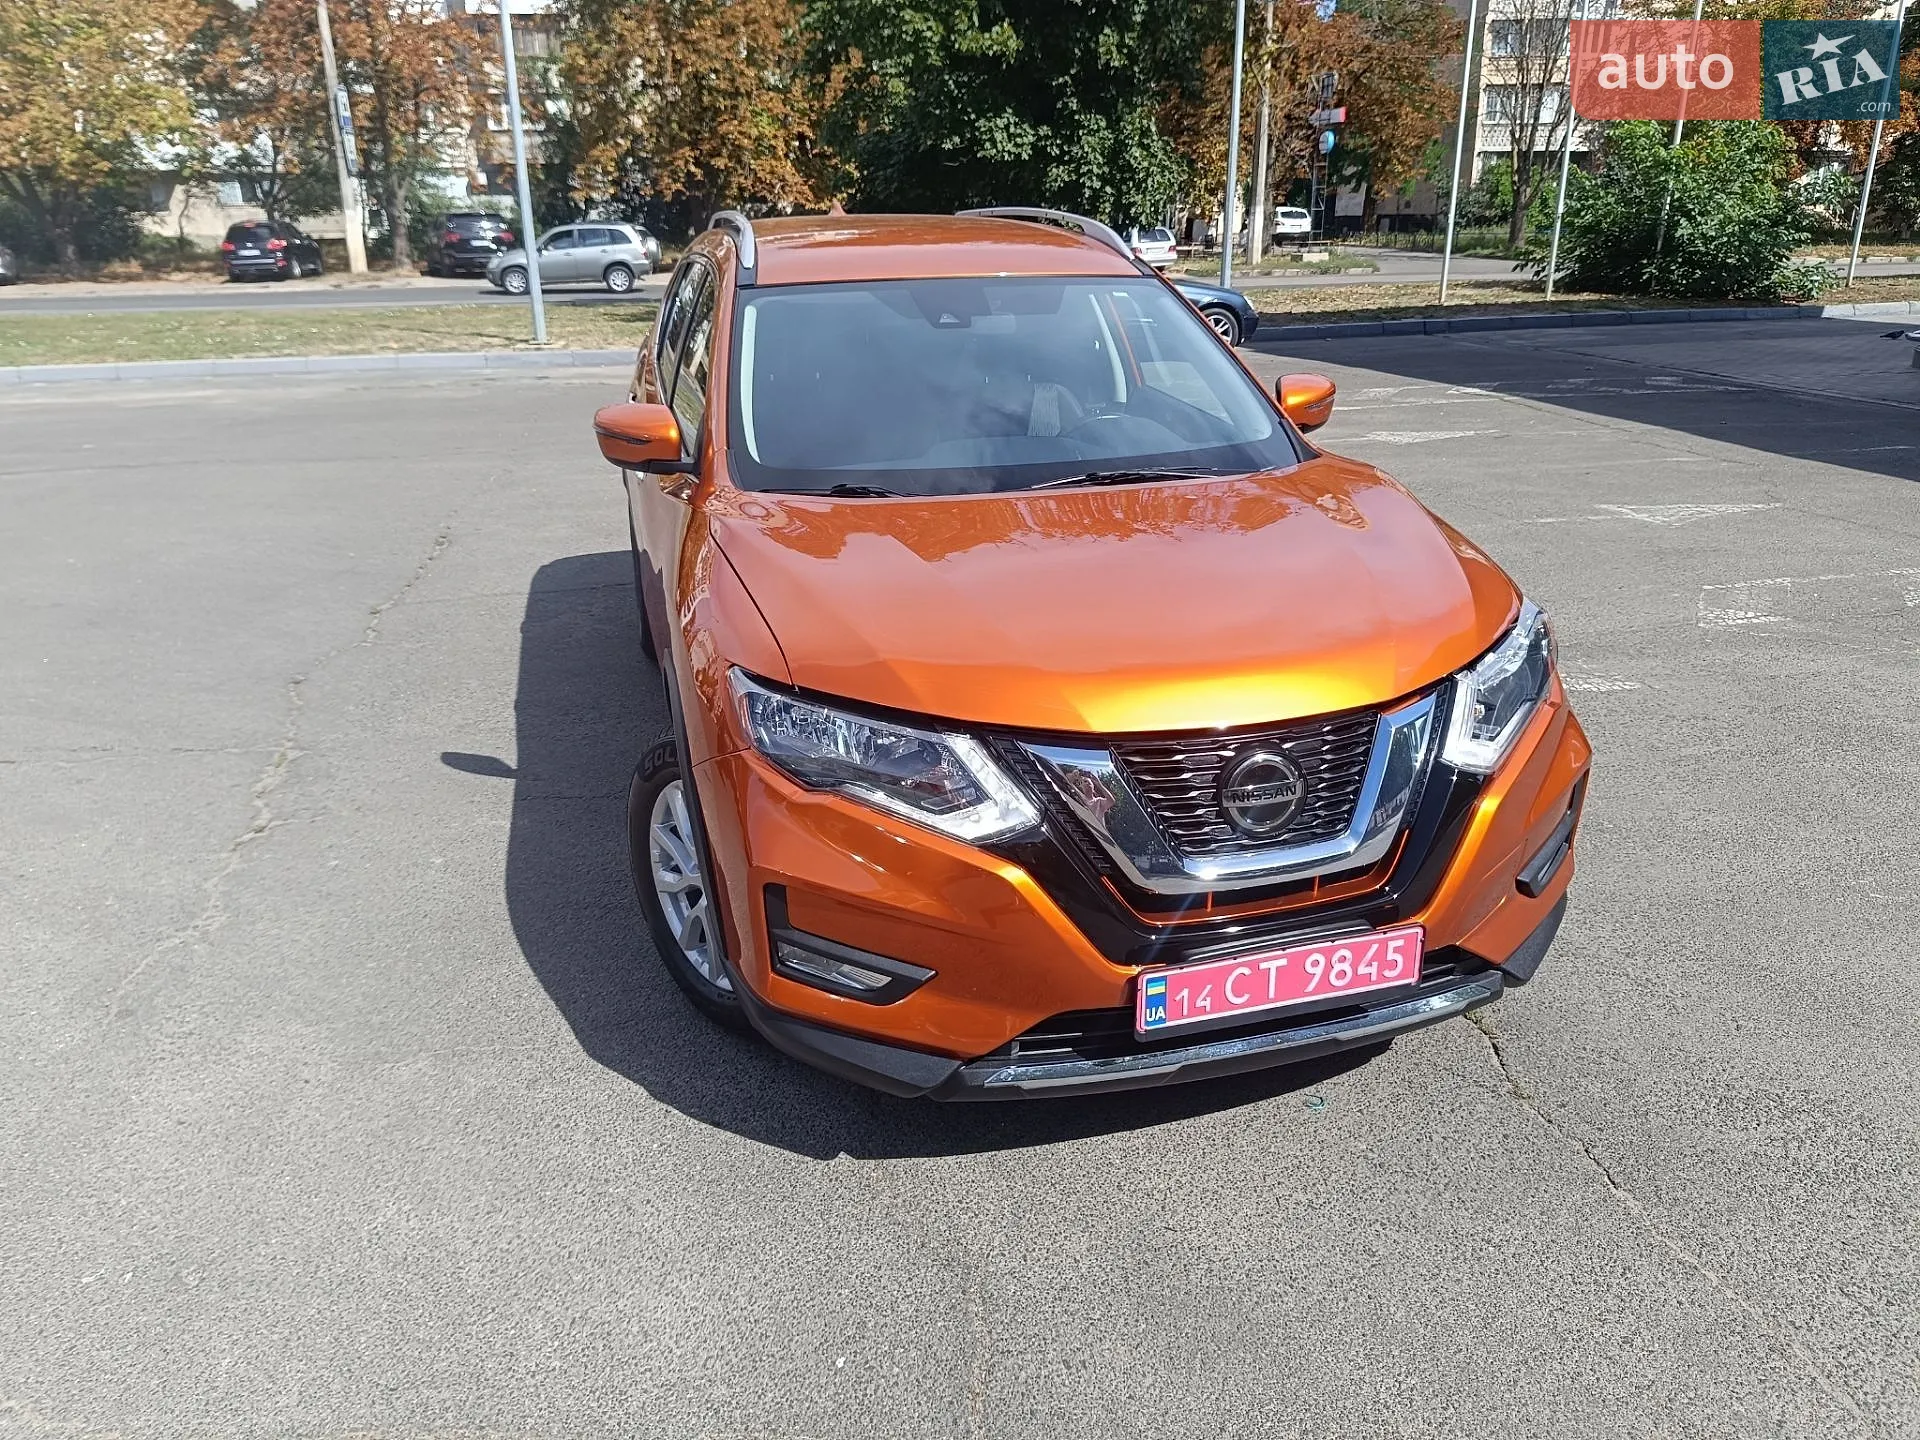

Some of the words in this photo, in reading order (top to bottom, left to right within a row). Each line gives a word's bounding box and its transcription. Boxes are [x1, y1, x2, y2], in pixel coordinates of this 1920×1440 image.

[1232, 785, 1297, 804] NISSAN
[1174, 984, 1212, 1016] 14
[1224, 958, 1288, 1005] CT
[1303, 939, 1405, 993] 9845
[1146, 1005, 1166, 1021] UA
